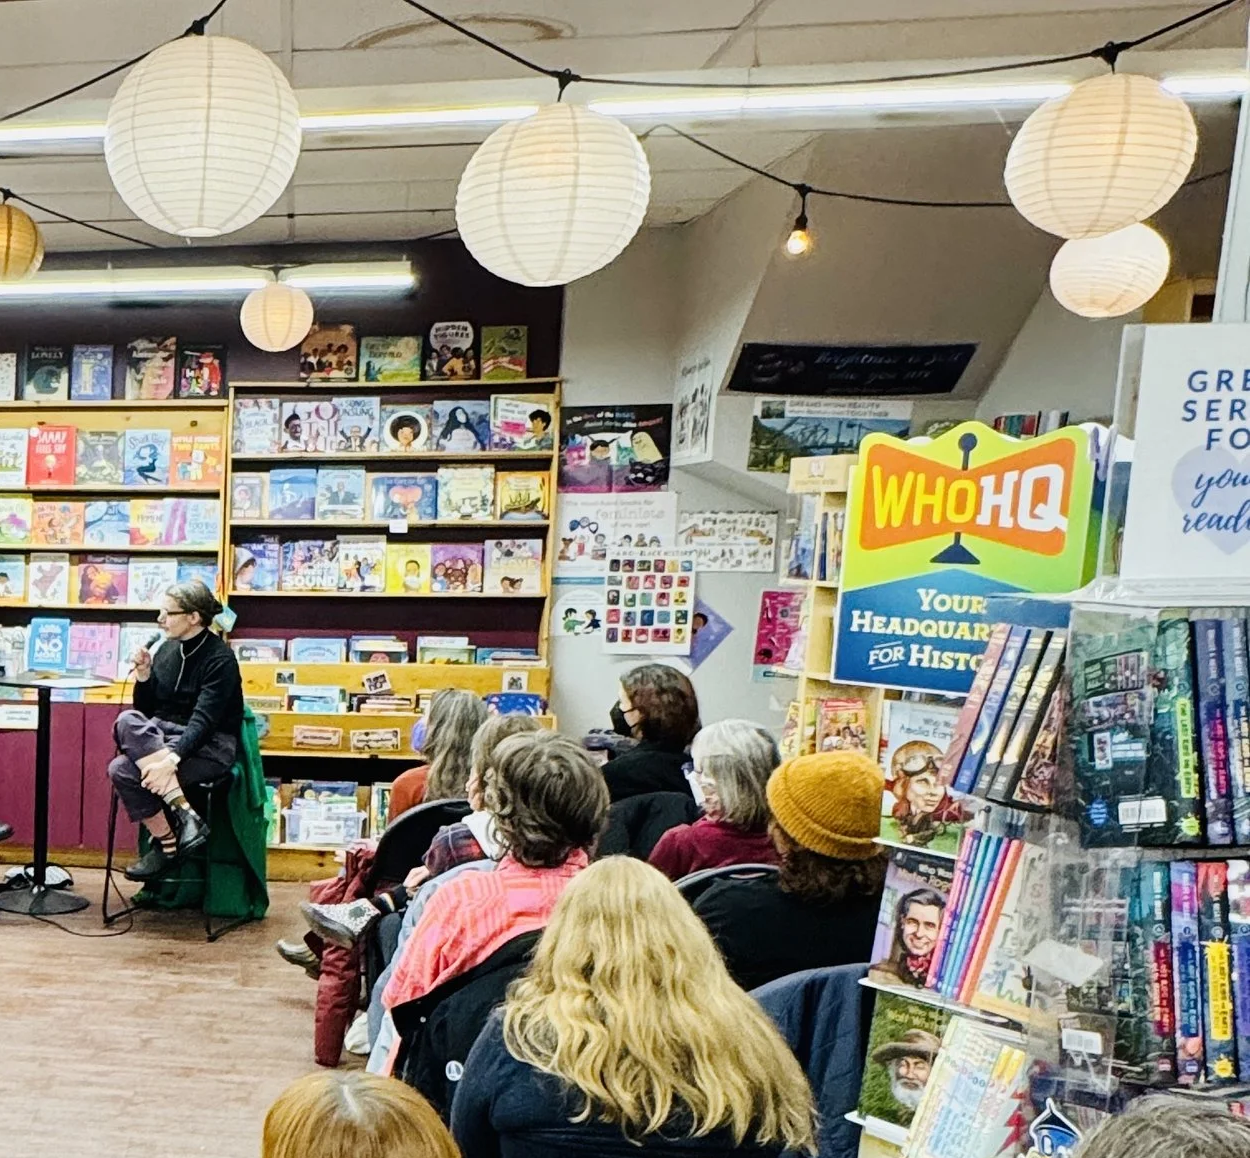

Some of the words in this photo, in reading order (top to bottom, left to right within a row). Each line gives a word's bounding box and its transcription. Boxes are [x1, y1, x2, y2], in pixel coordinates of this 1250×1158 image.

[1181, 398, 1246, 422] SER
[1205, 428, 1250, 451] FO
[595, 507, 665, 520] feminists
[281, 575, 336, 588] SOUND
[916, 587, 987, 615] YOUR
[850, 610, 997, 641] HEADQUAR
[35, 638, 63, 652] NO
[868, 647, 905, 665] FOR
